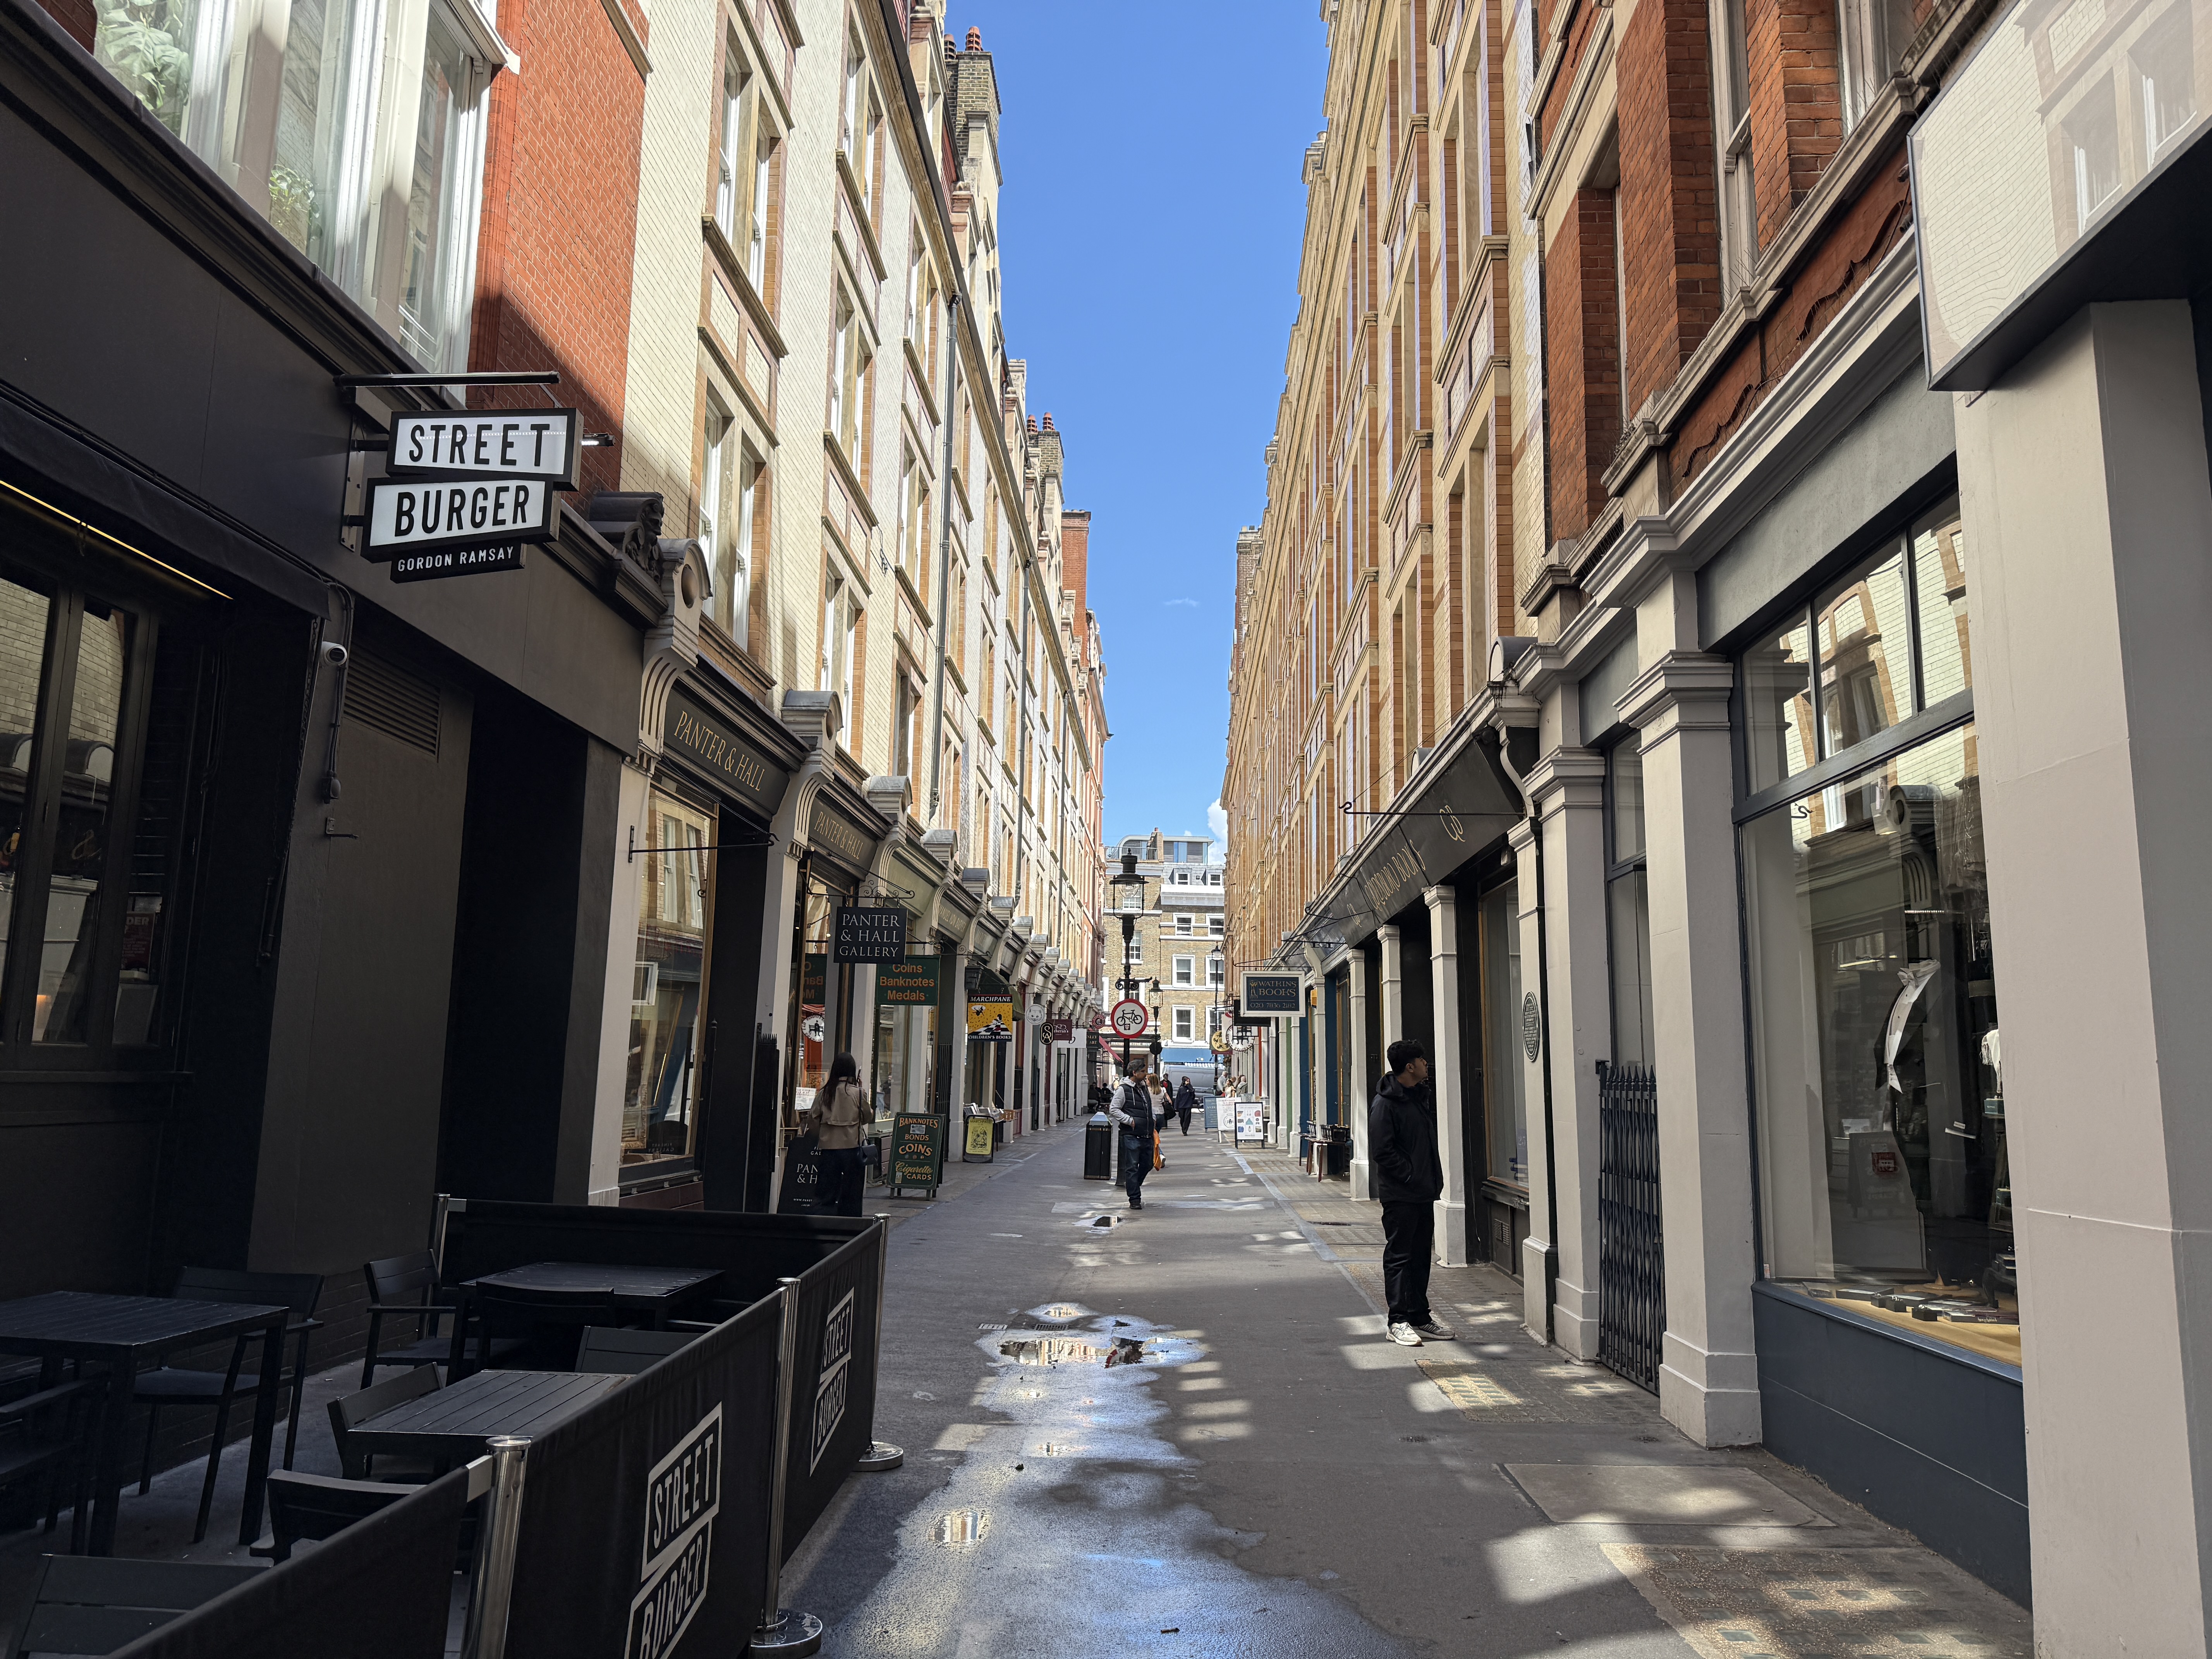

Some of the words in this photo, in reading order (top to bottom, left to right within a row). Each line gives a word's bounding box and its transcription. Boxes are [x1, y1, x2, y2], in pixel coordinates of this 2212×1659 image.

[409, 423, 550, 467] STREET
[394, 484, 529, 537] BURGER
[397, 553, 452, 572] GORDON
[459, 546, 514, 565] RAMSAY
[674, 710, 726, 766] PANTER
[725, 747, 737, 773] &
[734, 754, 765, 792] HALL
[814, 811, 843, 846] PANTER
[840, 830, 848, 849] &
[845, 834, 864, 860] HALL
[842, 914, 901, 927] PANTER
[840, 929, 853, 941] &
[858, 929, 900, 943] HALL
[839, 946, 899, 957] GALLERY
[892, 963, 923, 973] Coins
[879, 976, 935, 987] Banknotes
[887, 990, 926, 1001] Medals
[1259, 988, 1296, 997] BOOKS
[898, 1117, 939, 1128] BANKNOTES
[898, 1143, 933, 1156] COINS
[797, 1163, 818, 1173] PAN
[895, 1161, 933, 1175] Cigarette
[797, 1173, 806, 1183] &
[823, 1305, 850, 1368] STREET
[817, 1368, 844, 1448] BURGER
[653, 1432, 715, 1549] STREET
[639, 1534, 703, 1659] BURGER
